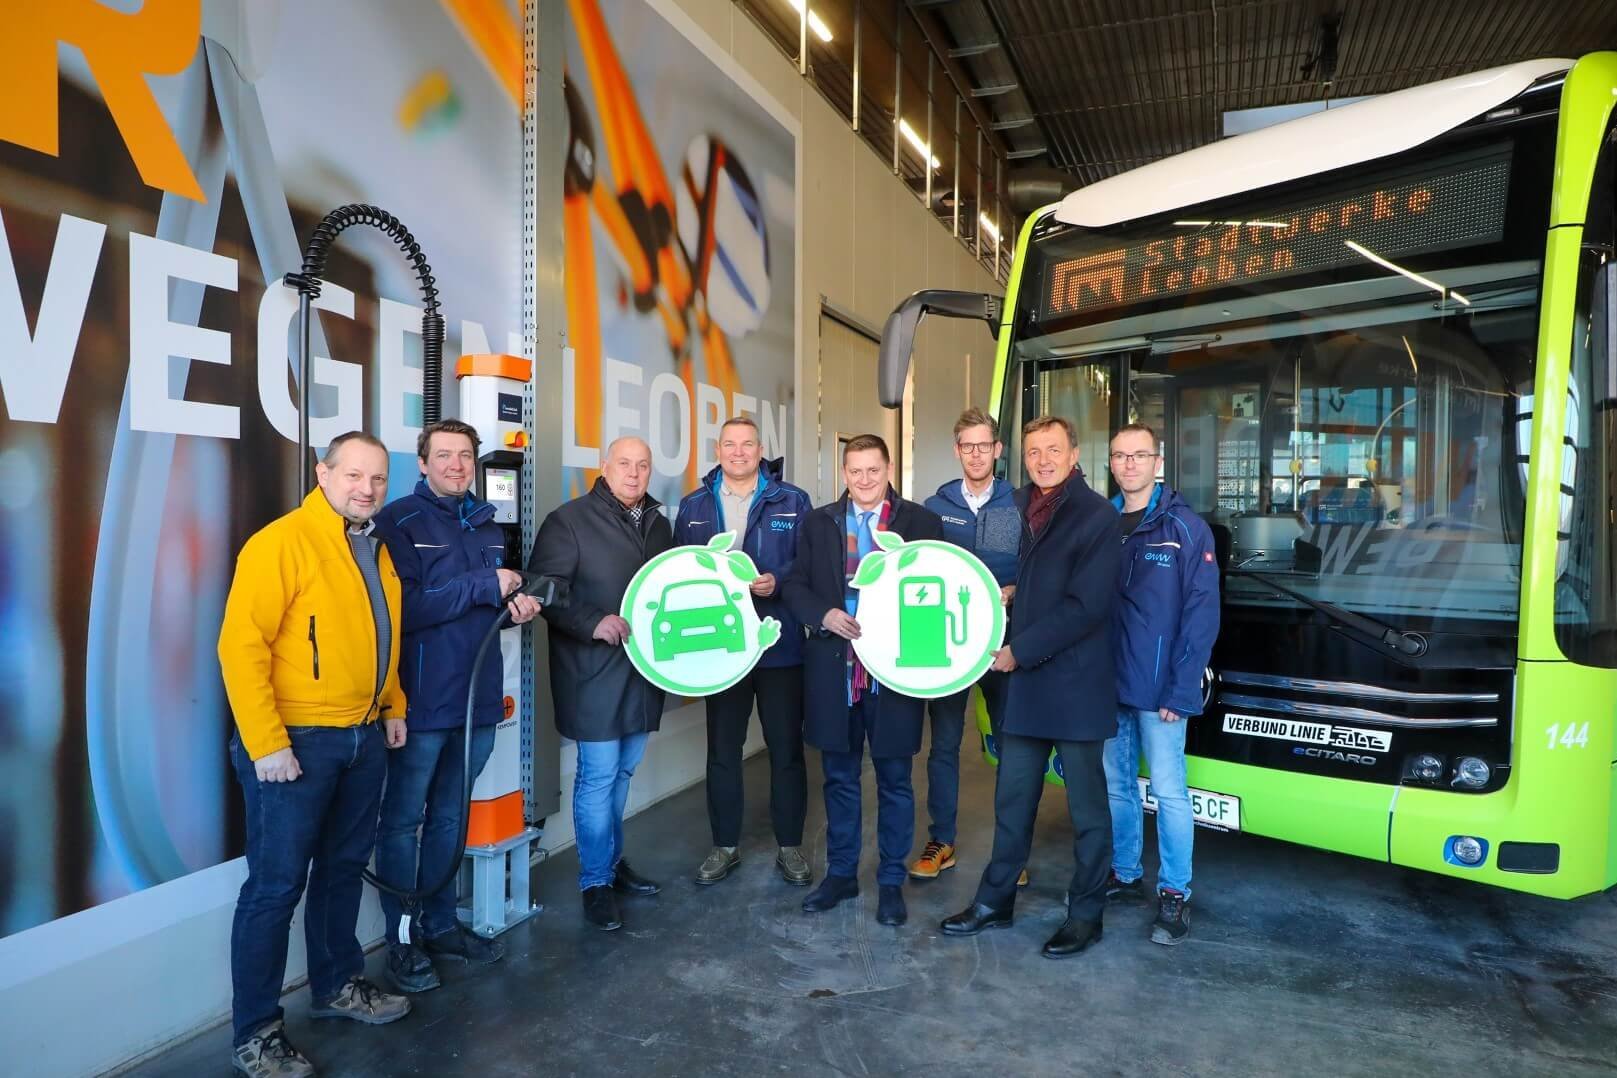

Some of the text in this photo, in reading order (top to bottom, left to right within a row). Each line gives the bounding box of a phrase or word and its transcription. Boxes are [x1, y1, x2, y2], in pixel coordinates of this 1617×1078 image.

[1146, 188, 1432, 267] Stadtwerke
[1139, 249, 1294, 297] Leoben
[1228, 717, 1326, 741] VERBUND LINIE
[1545, 720, 1590, 750] 144
[1293, 747, 1377, 766] eCITARO
[1207, 798, 1230, 820] CF
